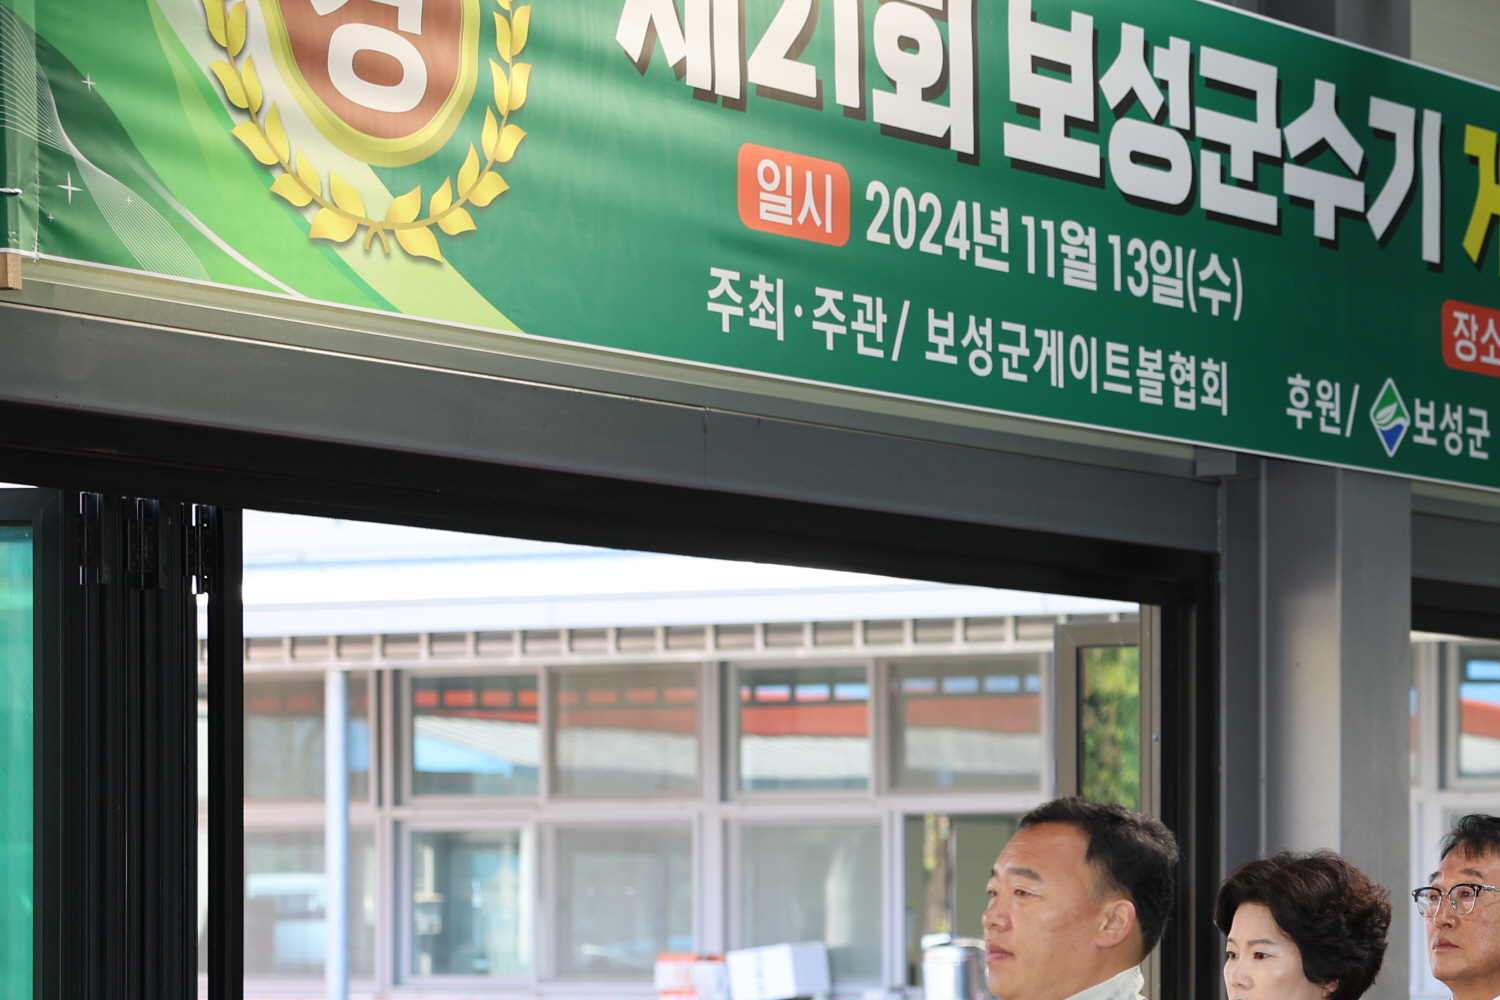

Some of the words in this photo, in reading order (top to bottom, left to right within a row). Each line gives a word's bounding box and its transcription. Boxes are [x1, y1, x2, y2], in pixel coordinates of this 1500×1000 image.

[1003, 0, 1443, 264] 보성군수기
[755, 158, 834, 234] 일시
[865, 180, 1010, 273] 2024년
[1021, 214, 1098, 292] 11월
[1107, 233, 1243, 321] 13일(수)
[925, 307, 1228, 416] 보성군게이트볼협회
[1286, 373, 1360, 438] 후원/
[1413, 398, 1491, 461] 보성군
